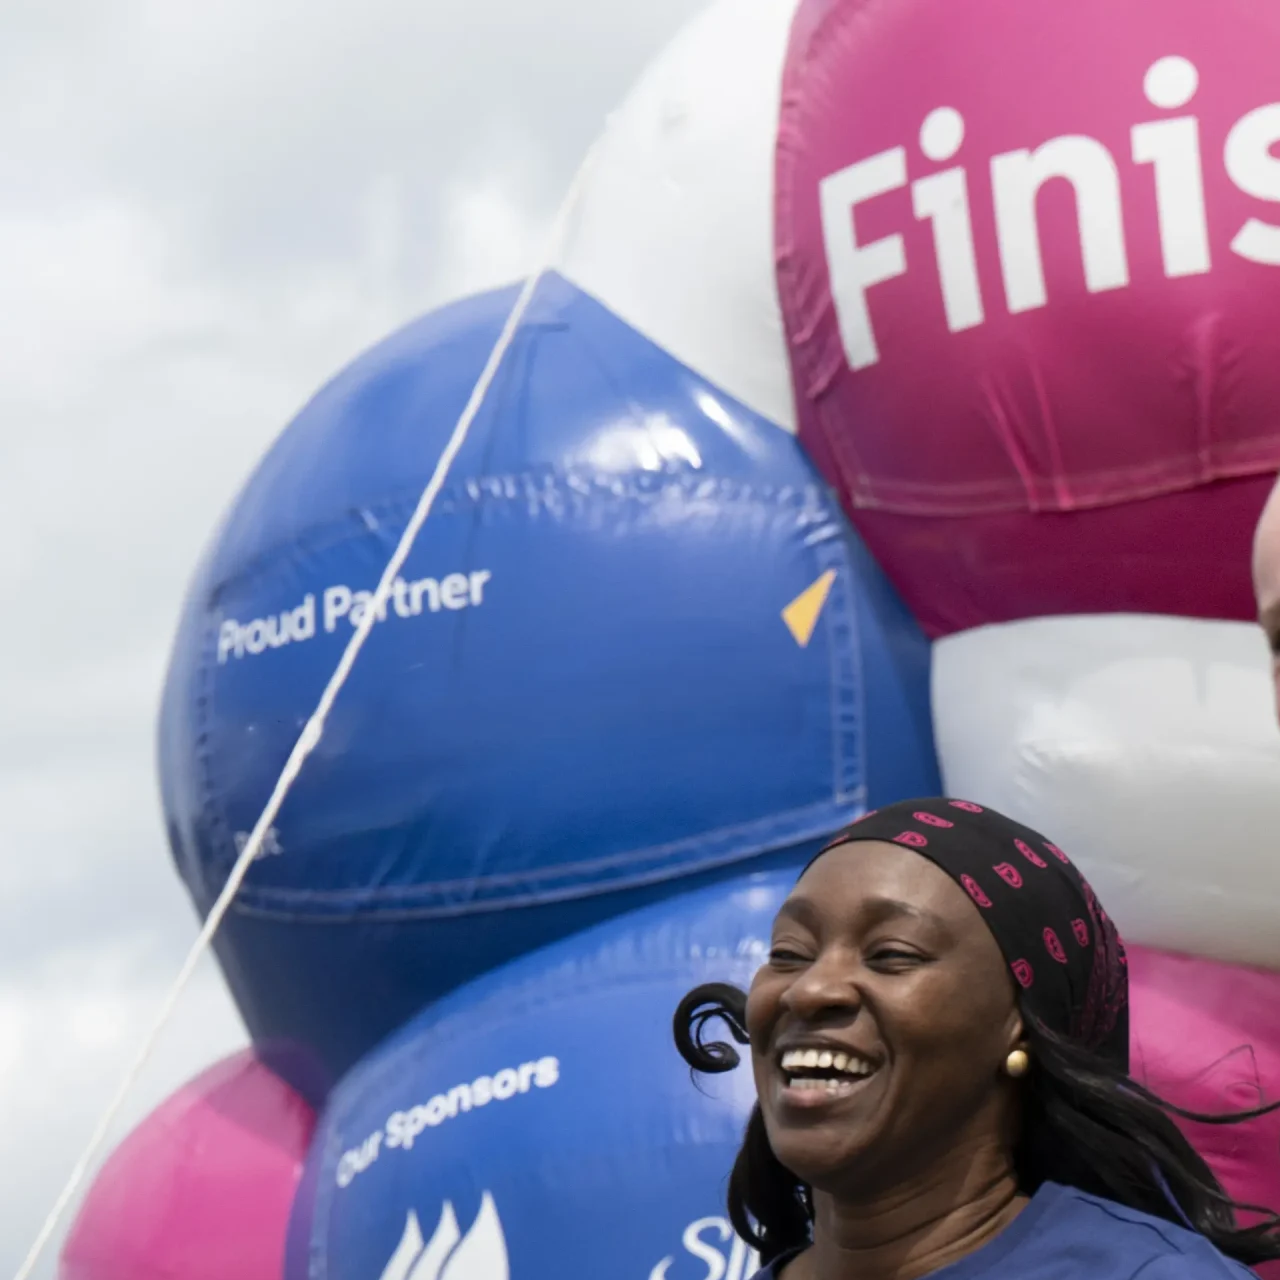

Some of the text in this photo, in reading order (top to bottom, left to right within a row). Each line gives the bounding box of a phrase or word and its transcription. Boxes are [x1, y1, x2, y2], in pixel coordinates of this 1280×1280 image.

[217, 569, 492, 664] Proud Partner
[336, 1055, 560, 1188] Our Sponsors
